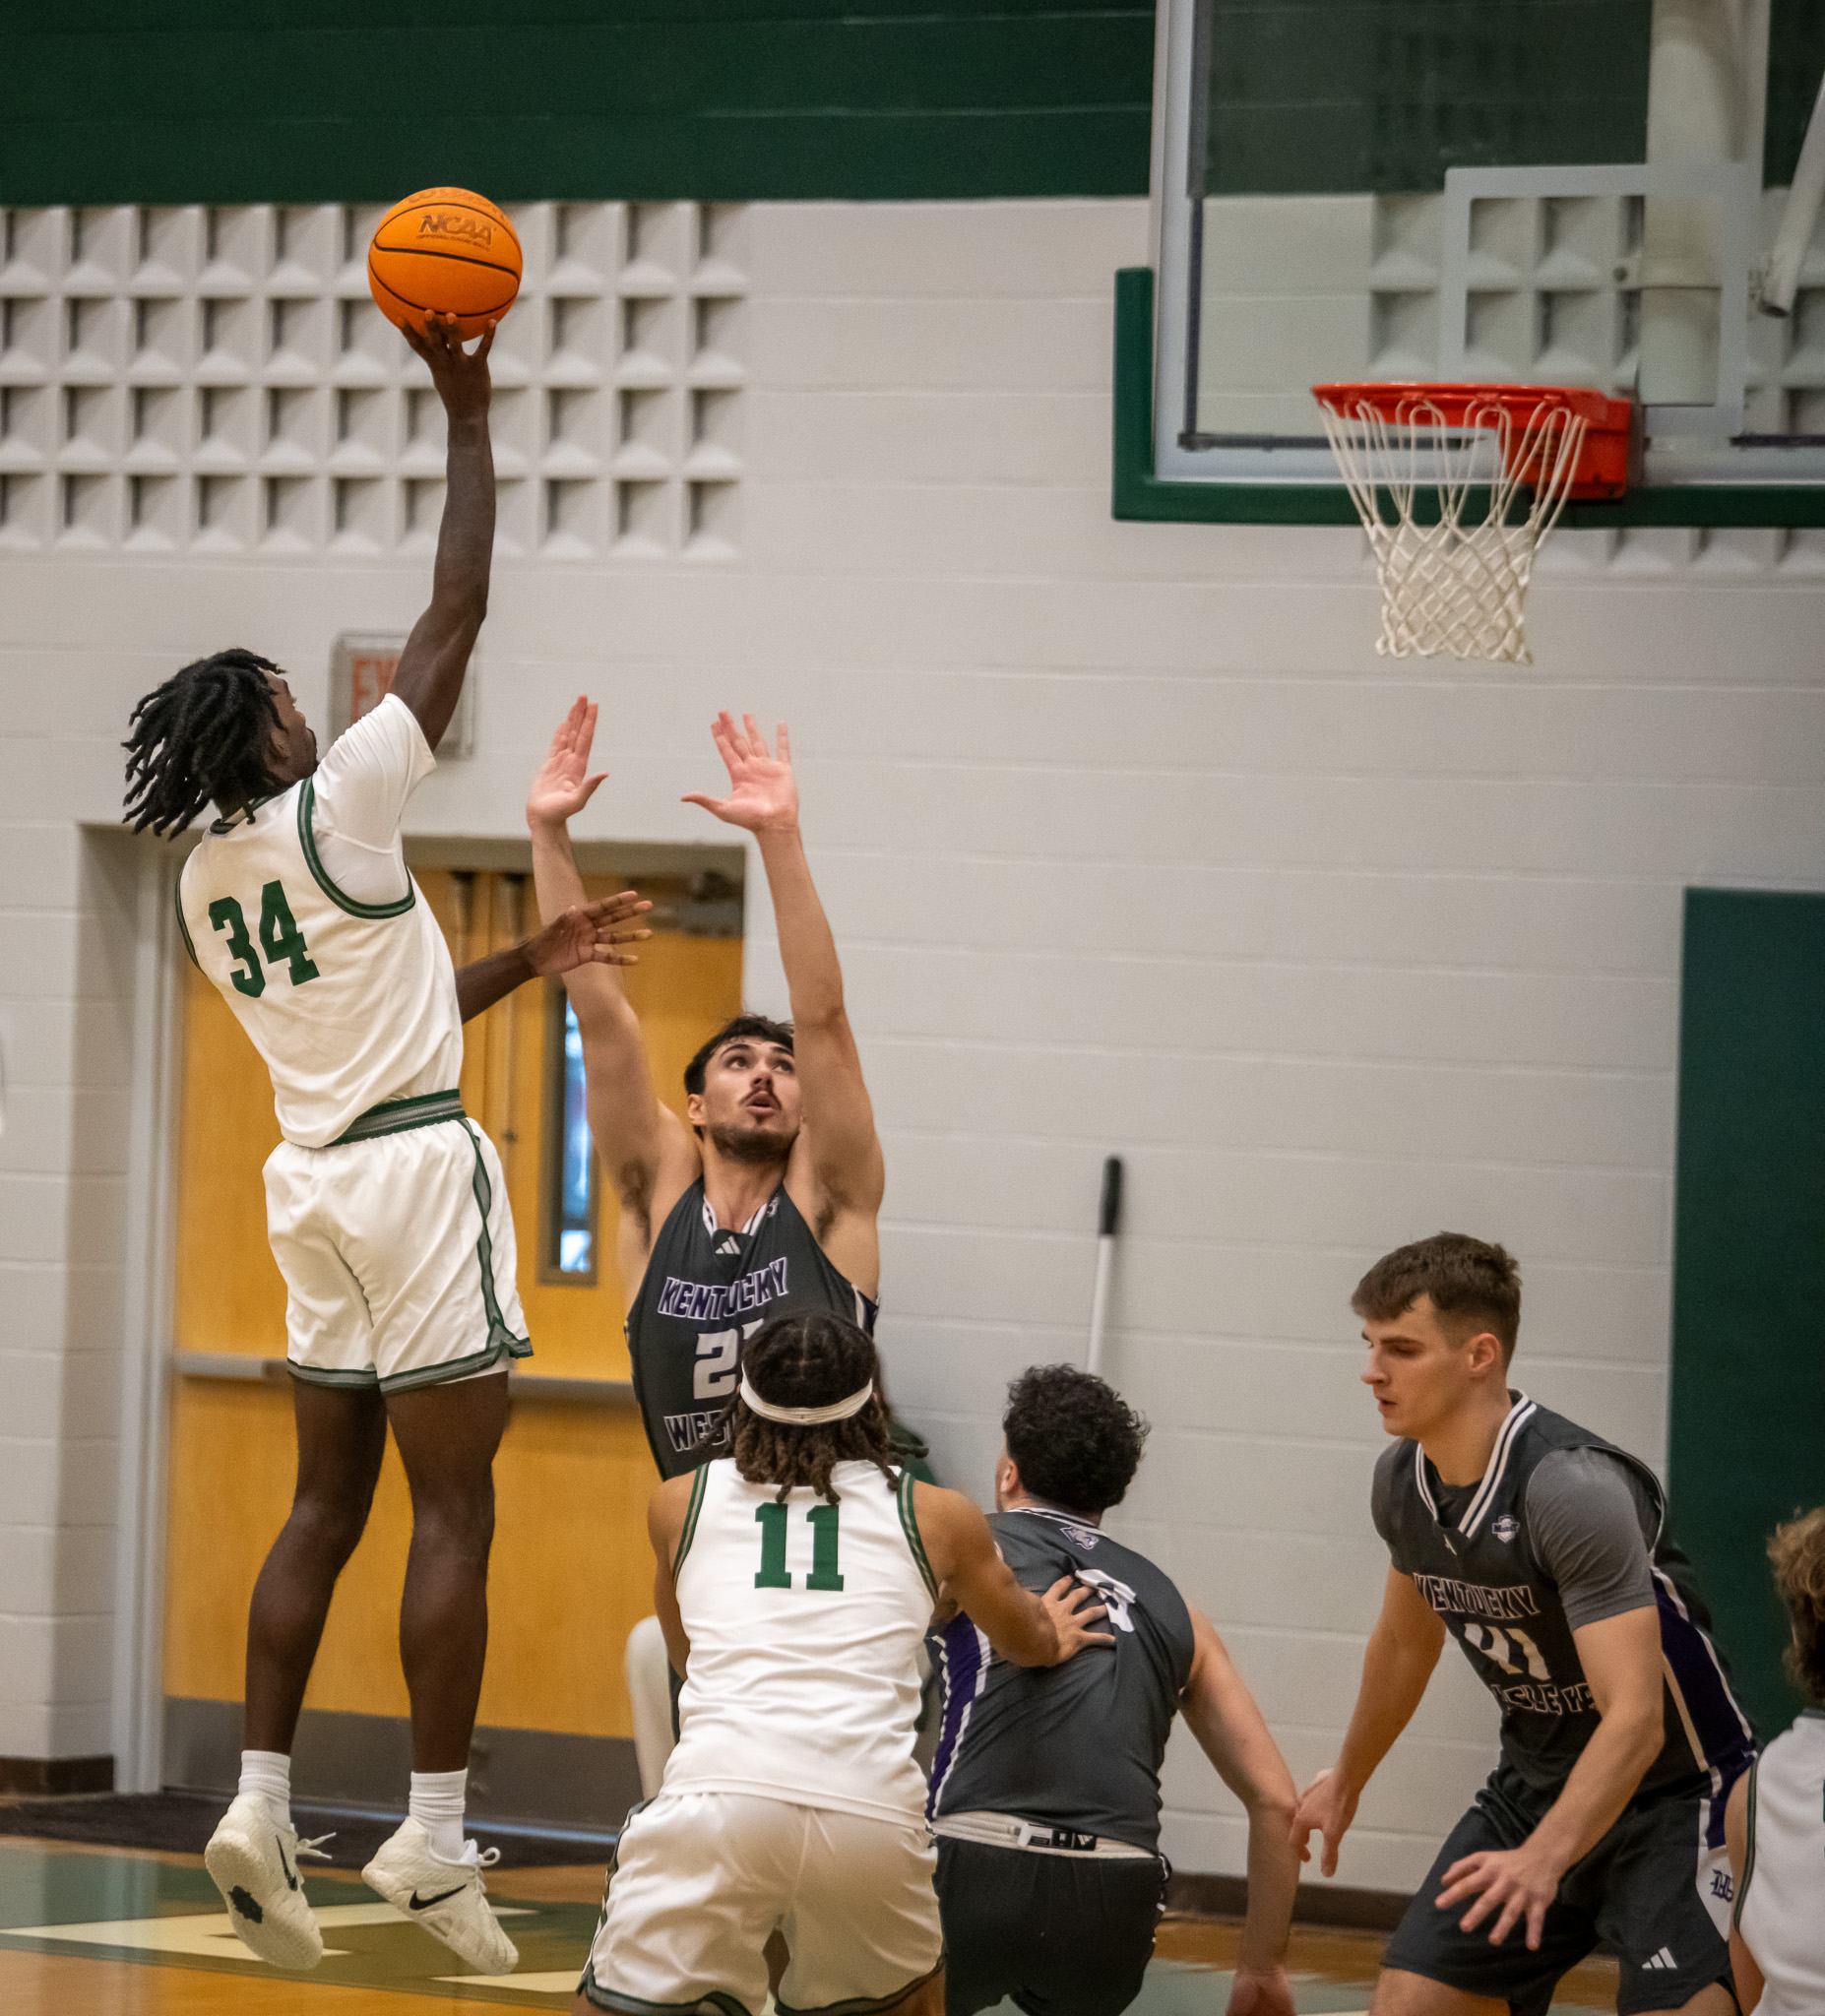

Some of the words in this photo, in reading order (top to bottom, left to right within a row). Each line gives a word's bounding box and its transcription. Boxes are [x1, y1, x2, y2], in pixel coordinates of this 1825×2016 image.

[419, 215, 492, 245] NCAA
[351, 658, 400, 724] EX
[209, 879, 320, 998] 34
[658, 1257, 789, 1320] KENTUCKY
[693, 1318, 764, 1400] 2
[754, 1501, 845, 1592] 11
[1412, 1572, 1542, 1619] KENTUCKY
